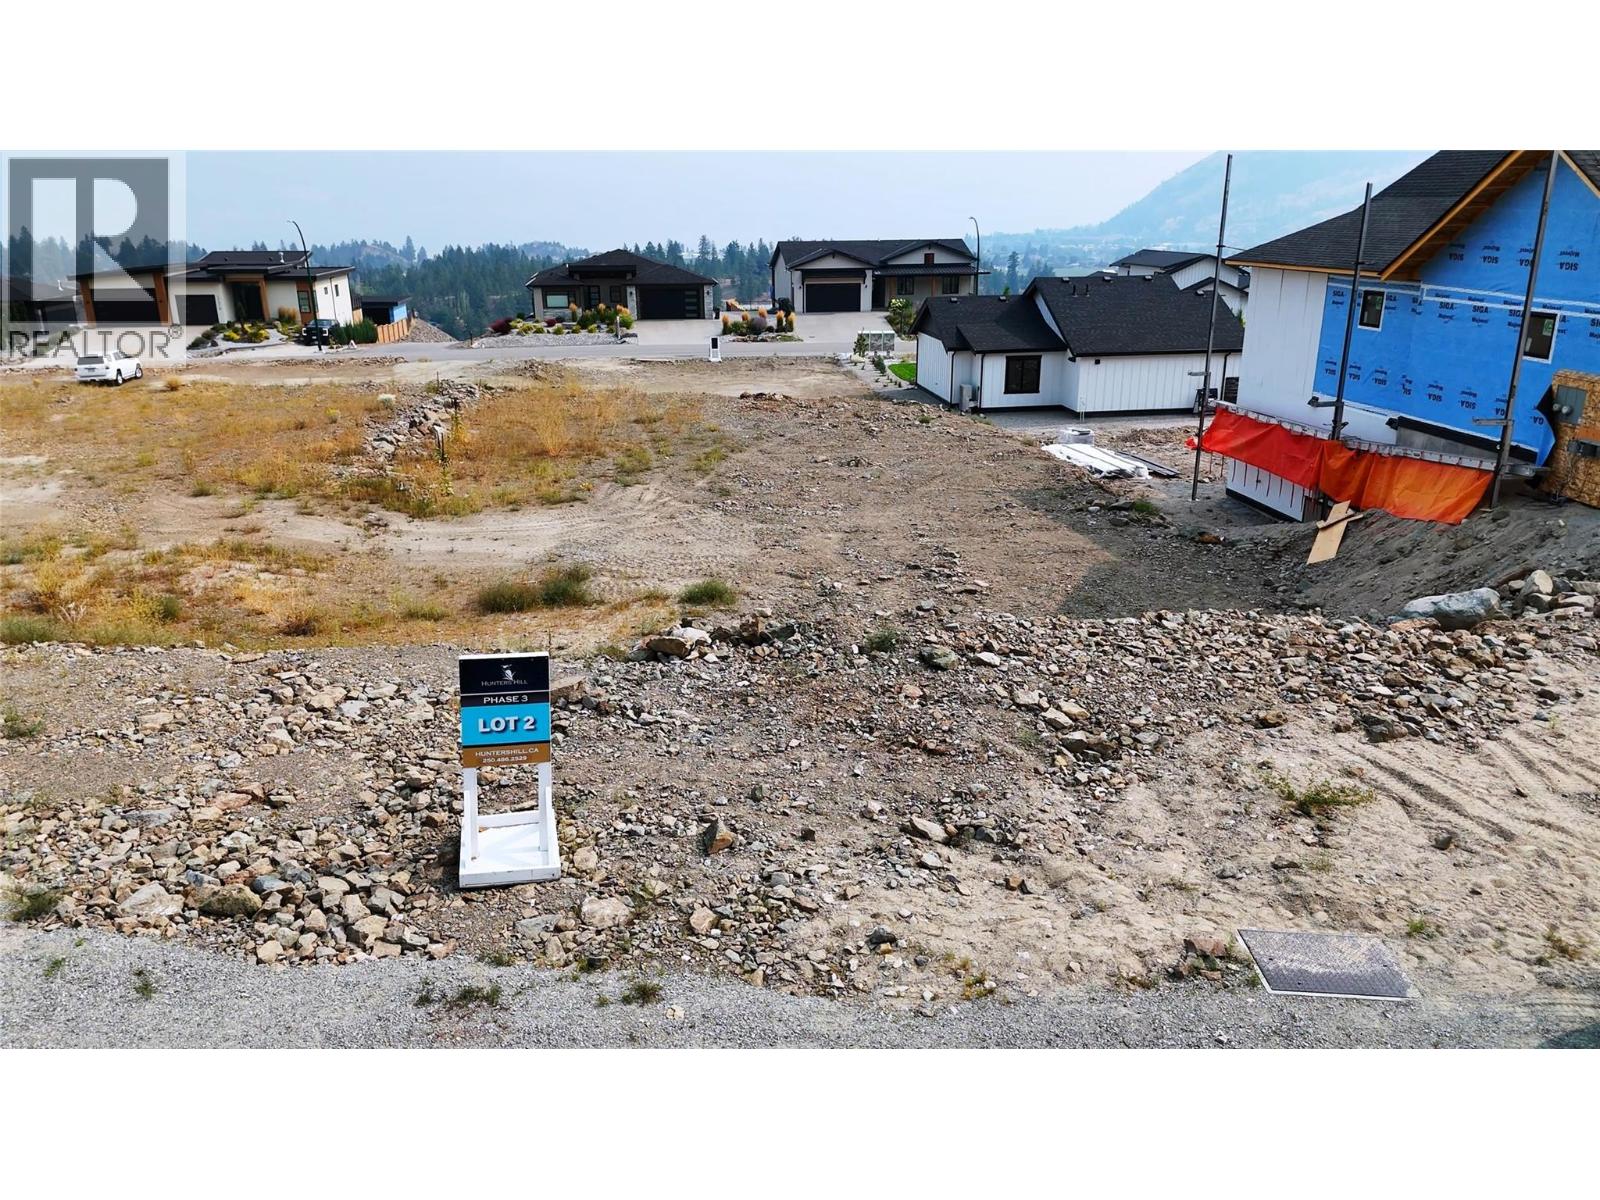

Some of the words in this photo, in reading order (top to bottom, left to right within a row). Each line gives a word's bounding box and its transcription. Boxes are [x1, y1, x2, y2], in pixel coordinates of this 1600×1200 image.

[1482, 255, 1499, 264] SIGA
[1559, 261, 1579, 271] SIGA
[1439, 301, 1455, 310] SIGA
[1472, 305, 1489, 314] SIGA
[1427, 393, 1442, 402] SIGA
[1460, 400, 1476, 410] SIGA
[483, 696, 519, 704] PHASE
[478, 715, 519, 733] LOT
[523, 716, 535, 730] 2
